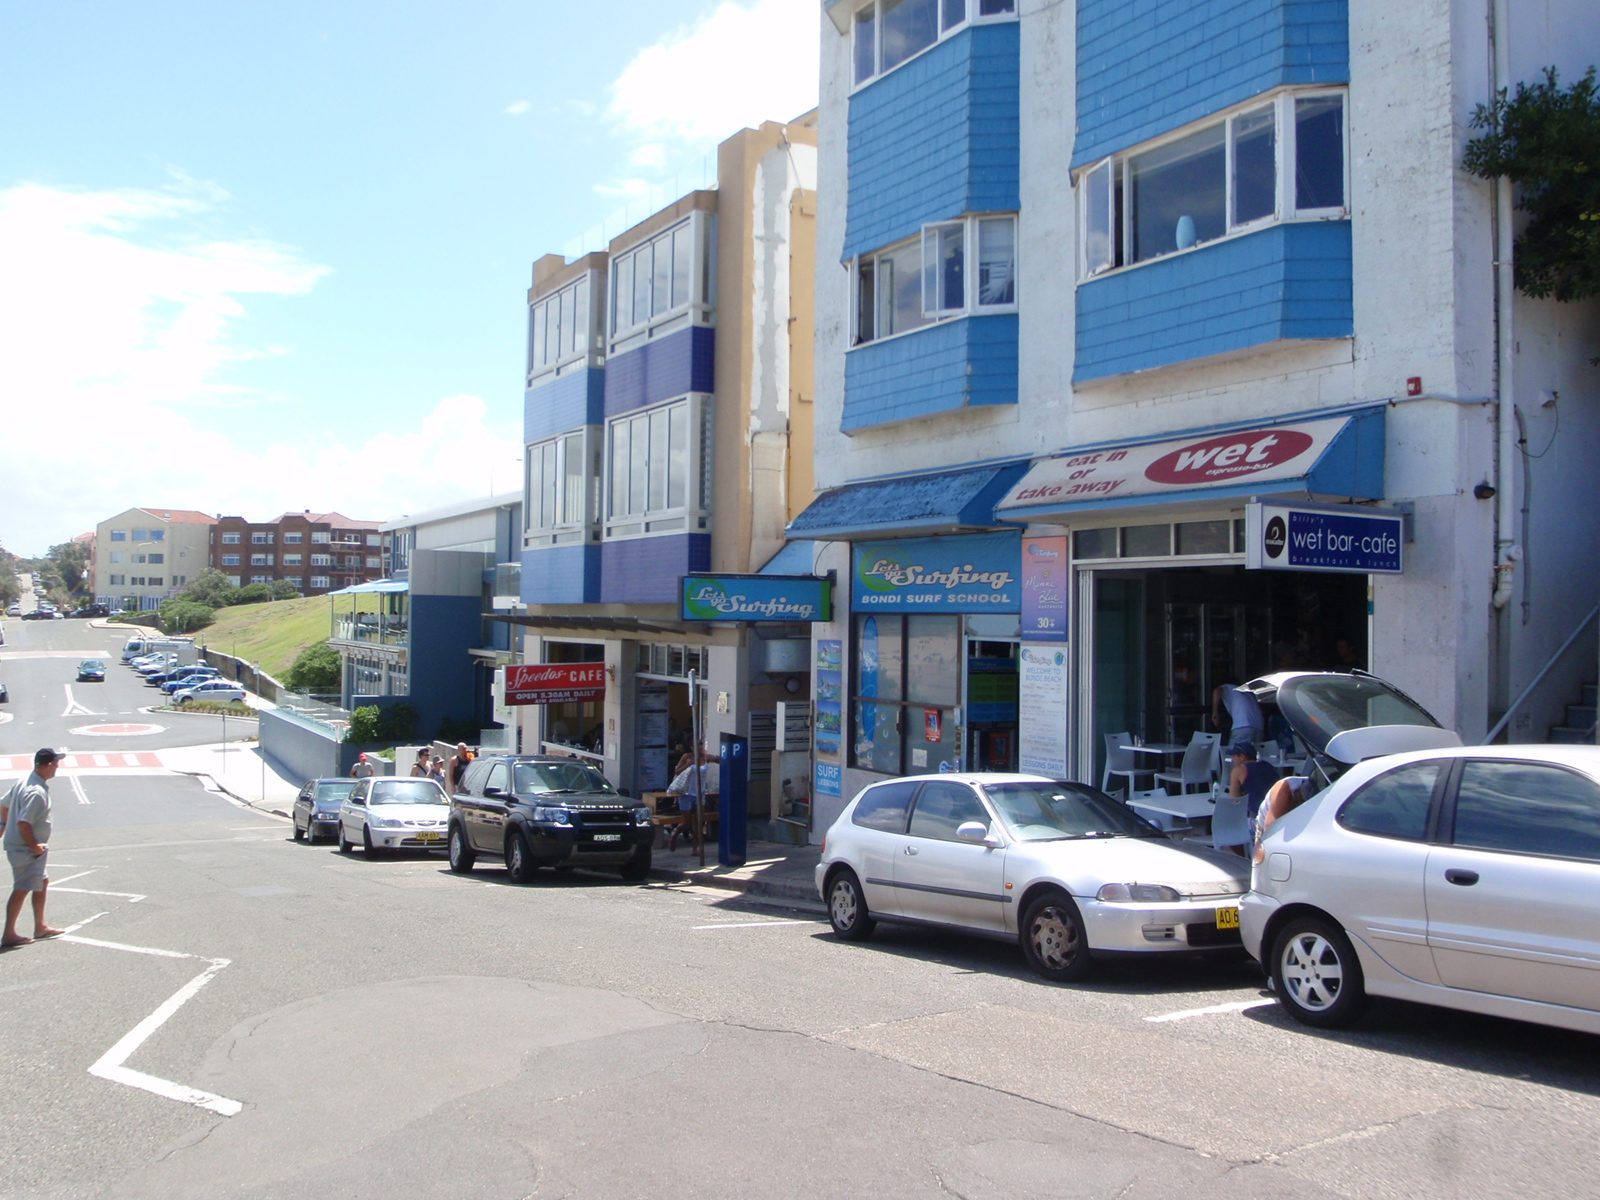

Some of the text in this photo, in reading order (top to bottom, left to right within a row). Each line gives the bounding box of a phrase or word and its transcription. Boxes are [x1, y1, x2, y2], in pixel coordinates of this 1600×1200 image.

[1066, 450, 1128, 468] eat in
[1173, 434, 1280, 472] wet
[1069, 467, 1096, 480] or
[1205, 462, 1274, 476] espresso-bar
[1016, 479, 1128, 501] take away
[1292, 528, 1323, 550] wet
[1292, 555, 1349, 565] breakfast
[890, 564, 1014, 589] Surfing
[716, 594, 816, 618] Surfing
[862, 594, 1010, 604] BONDI SURF SCHOOL
[508, 667, 603, 689] Speedos CAFE
[516, 692, 538, 700] OPEN
[721, 744, 726, 758] P
[733, 743, 740, 756] P
[817, 764, 839, 779] SURF
